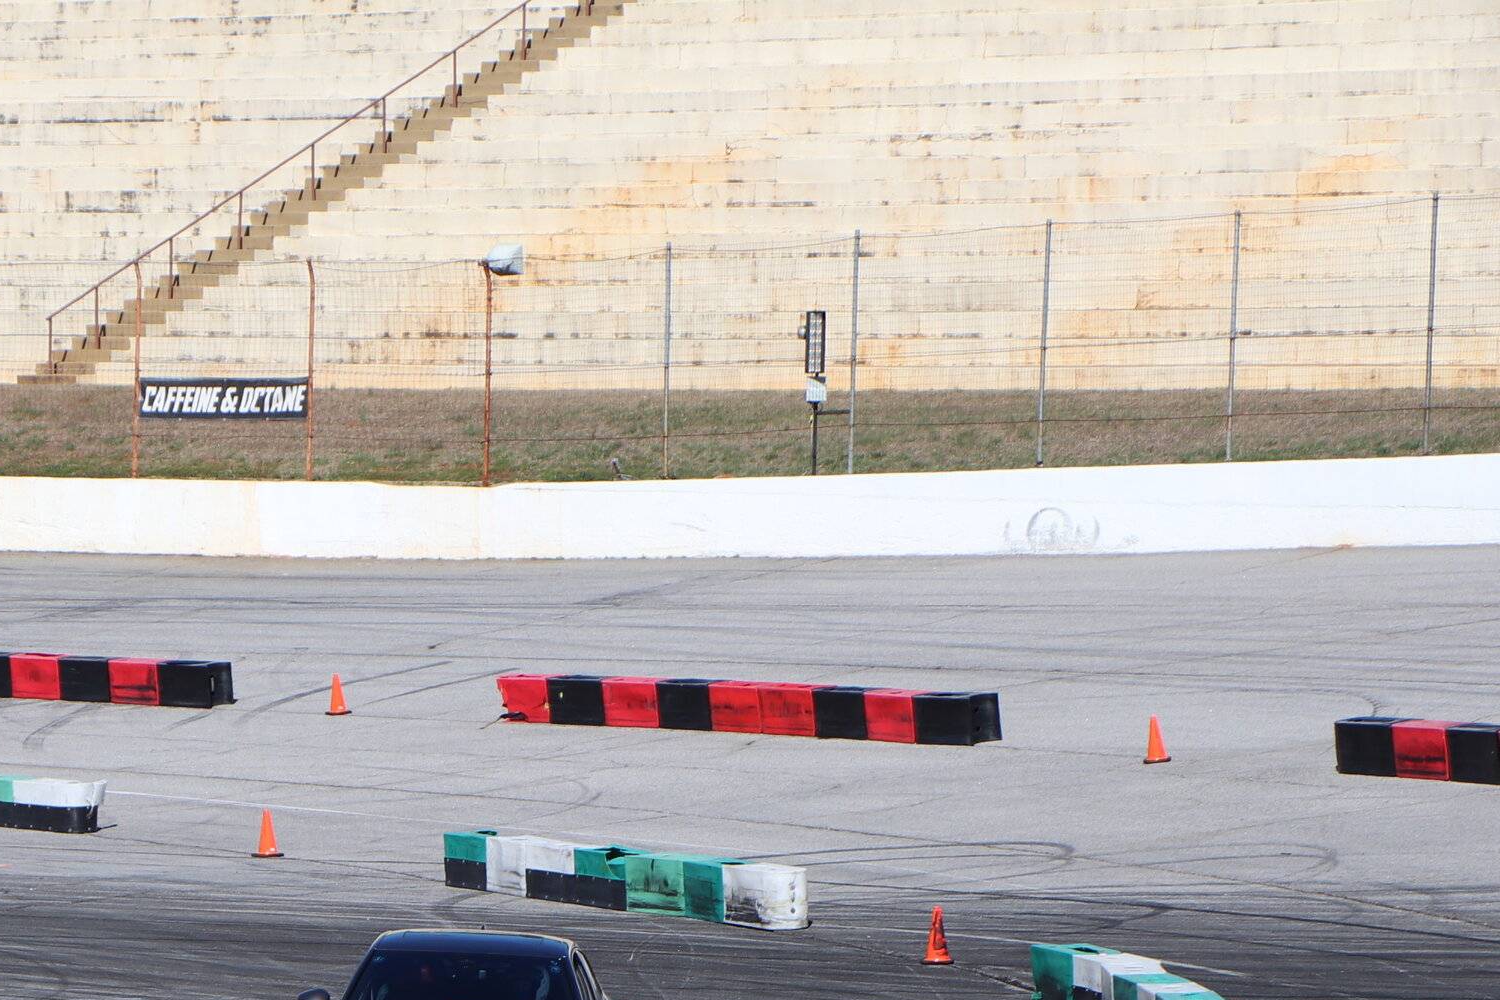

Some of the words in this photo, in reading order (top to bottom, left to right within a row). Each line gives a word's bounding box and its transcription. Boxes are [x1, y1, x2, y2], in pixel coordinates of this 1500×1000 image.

[141, 385, 221, 413] CAFFEINE
[220, 386, 238, 413] &
[239, 384, 307, 413] OCTANE
